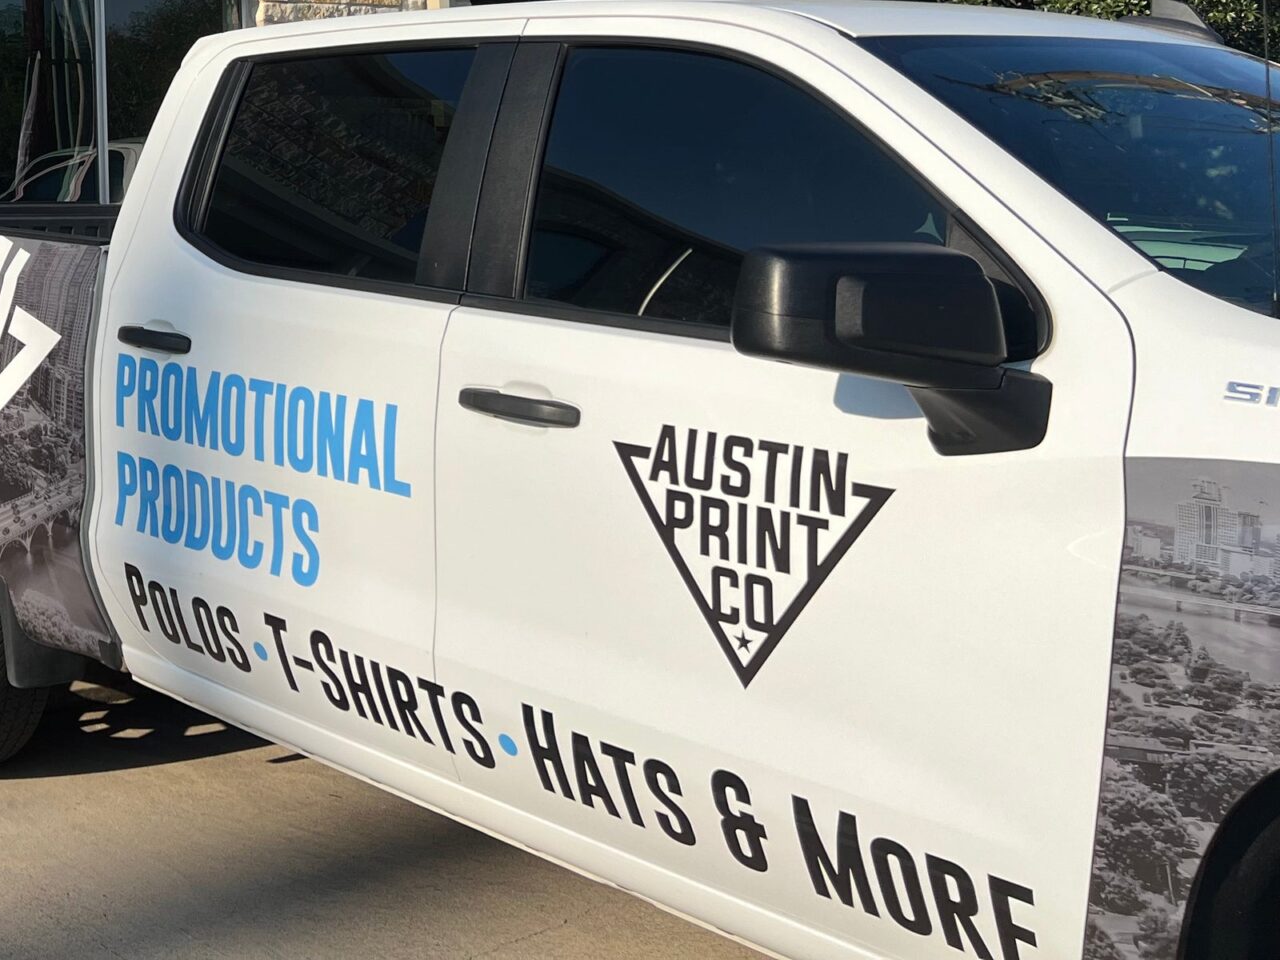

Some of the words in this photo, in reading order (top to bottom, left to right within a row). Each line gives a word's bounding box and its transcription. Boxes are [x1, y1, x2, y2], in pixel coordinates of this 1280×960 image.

[116, 353, 411, 498] PROMOTIONAL
[648, 424, 849, 517] AUSTIN
[115, 451, 320, 588] PRODUCTS
[665, 488, 829, 581] PRINT
[711, 565, 775, 634] CO
[124, 562, 252, 673] POLOS
[264, 612, 496, 769] T-SHIRTS
[521, 702, 697, 846] HATS
[711, 768, 768, 873] &
